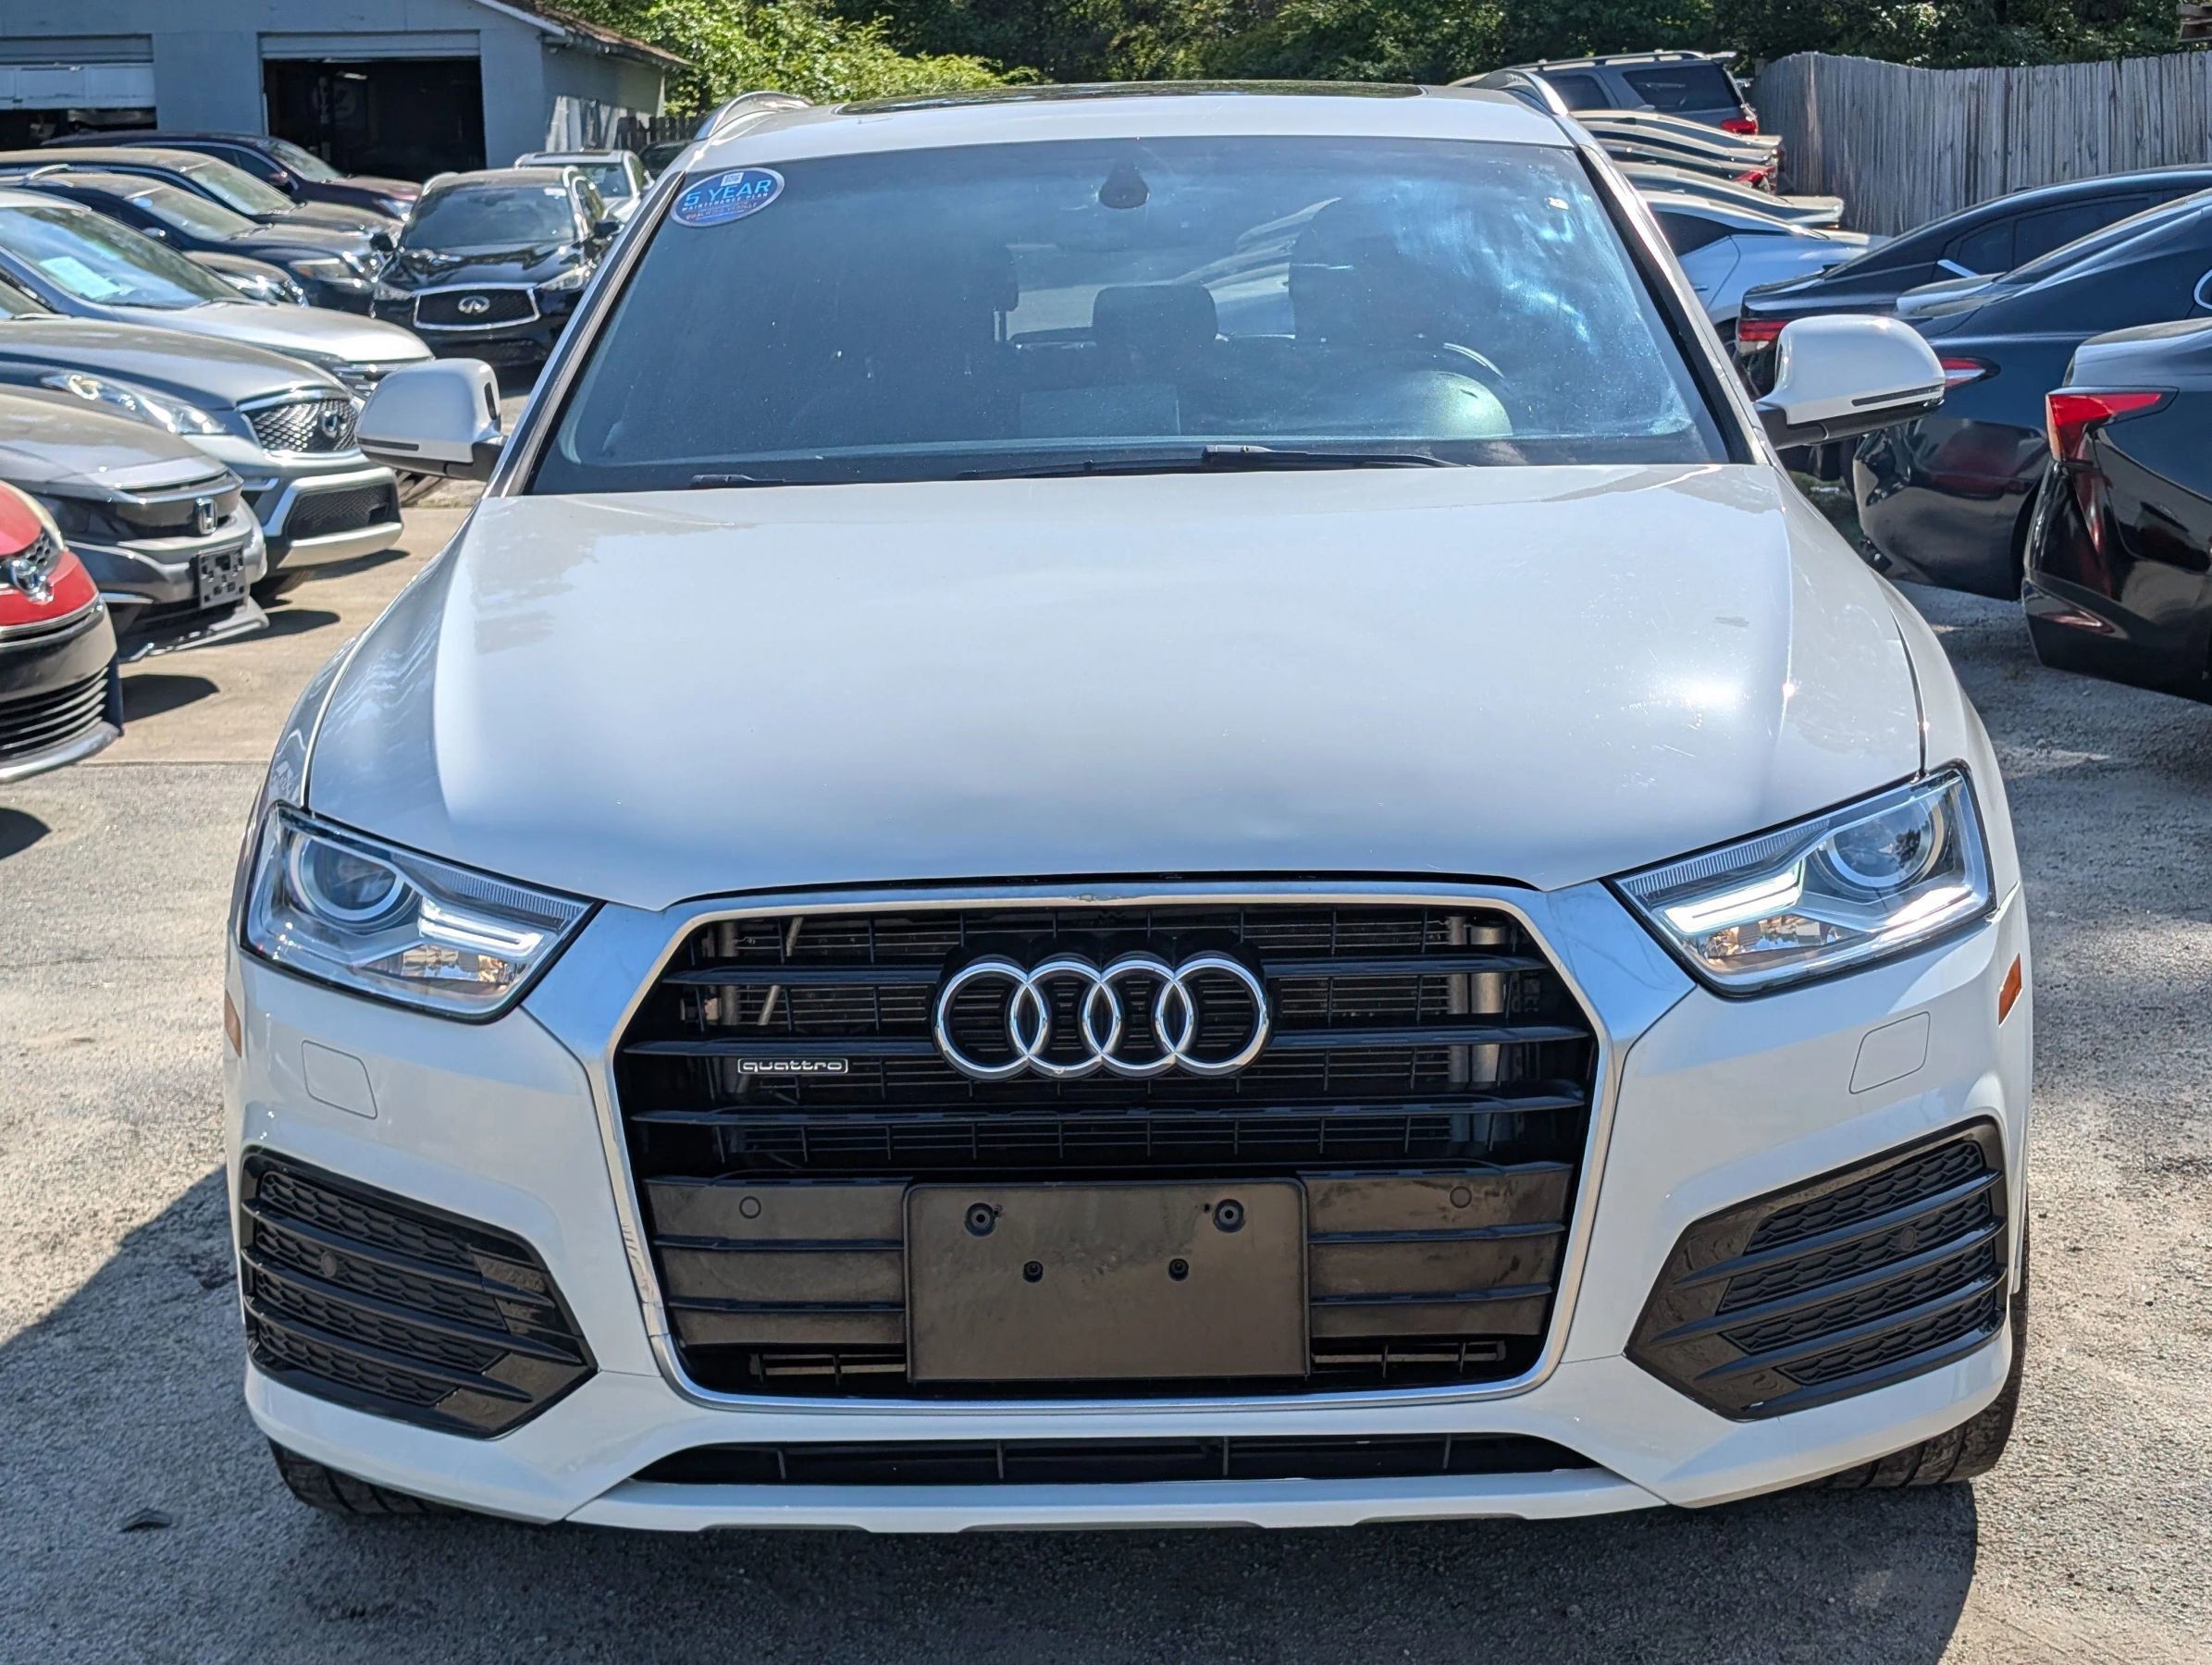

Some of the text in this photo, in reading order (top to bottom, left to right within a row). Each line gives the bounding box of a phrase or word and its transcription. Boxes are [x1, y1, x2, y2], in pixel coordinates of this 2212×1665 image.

[684, 191, 701, 206] 5
[709, 179, 772, 201] YEAR
[743, 1060, 842, 1072] quattro
